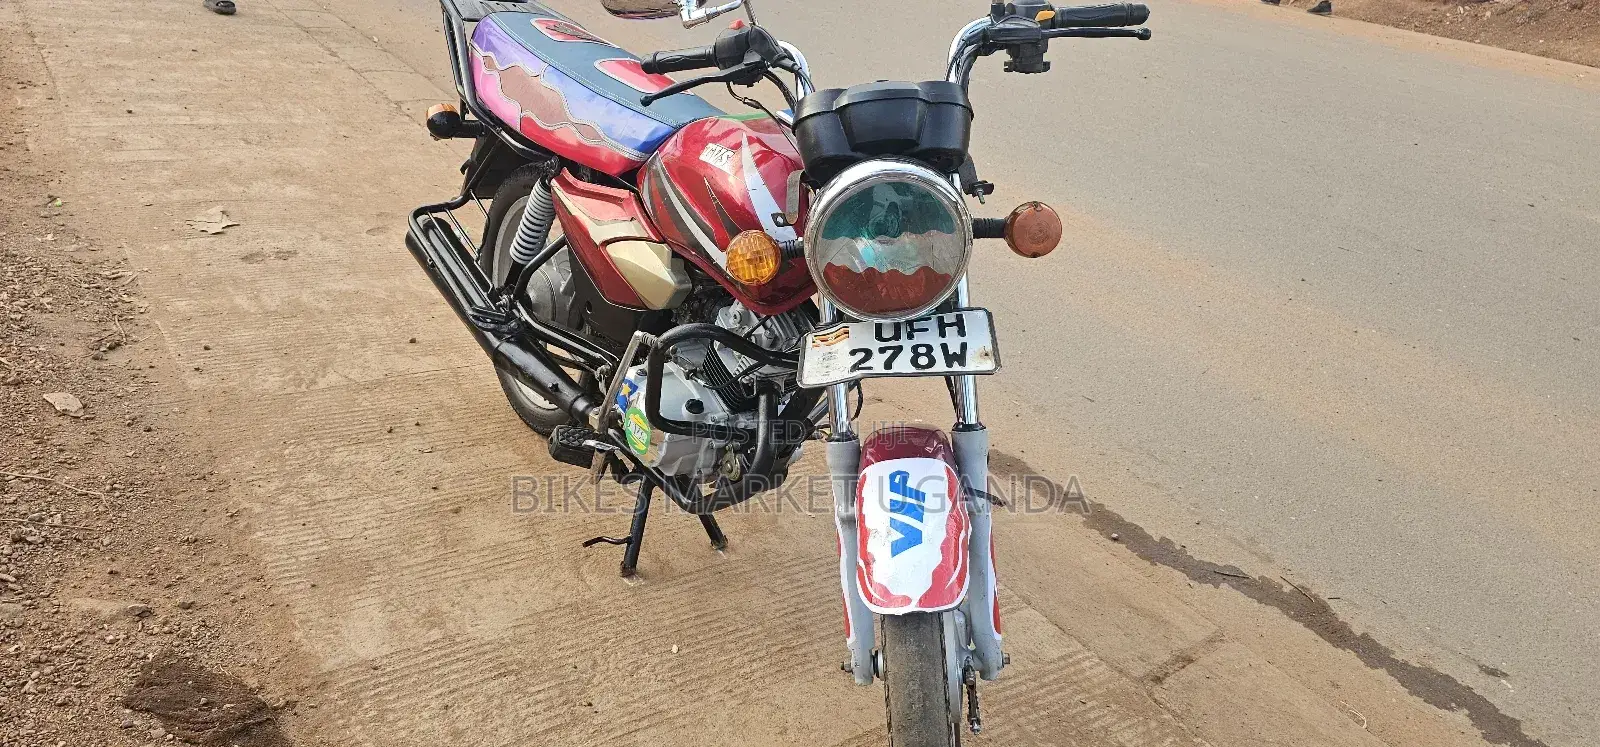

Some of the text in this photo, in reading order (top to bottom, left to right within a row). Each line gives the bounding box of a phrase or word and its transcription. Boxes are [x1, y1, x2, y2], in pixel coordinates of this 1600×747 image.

[874, 313, 967, 342] UFH
[849, 342, 968, 372] 278W
[888, 469, 926, 559] VIP
